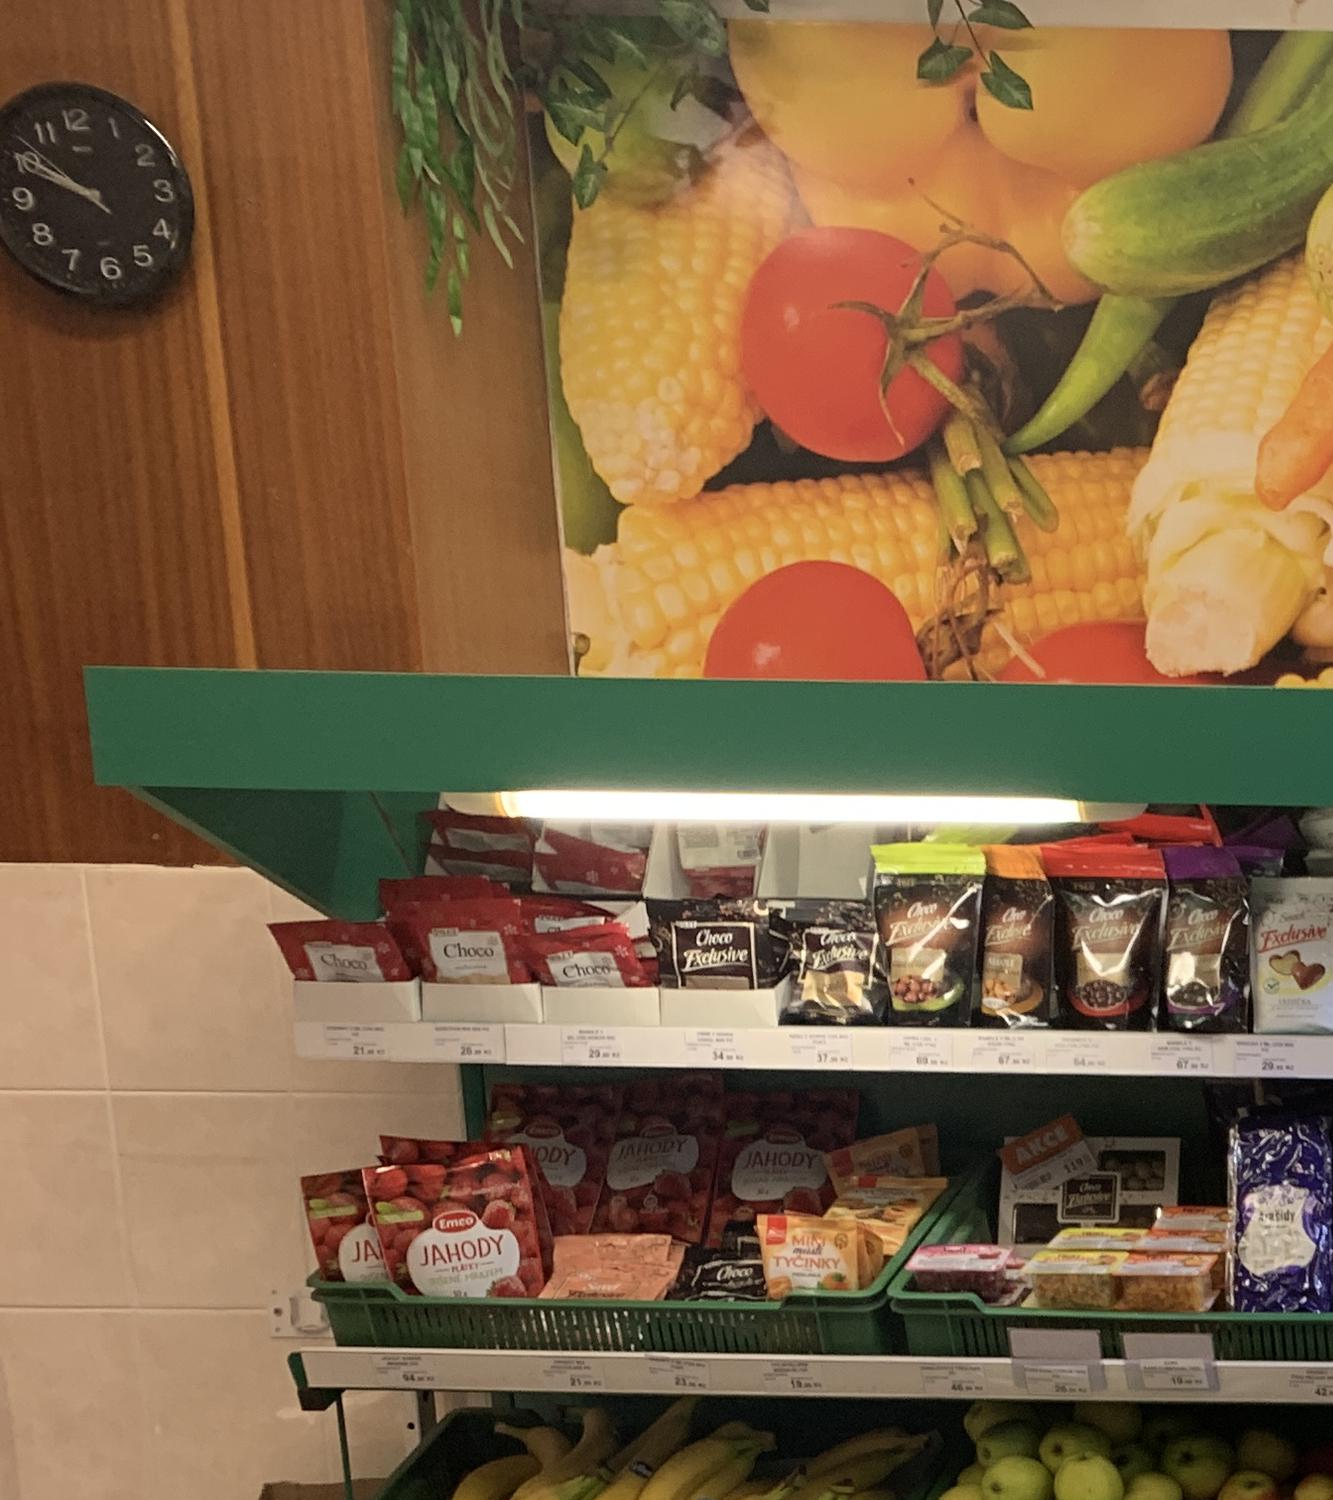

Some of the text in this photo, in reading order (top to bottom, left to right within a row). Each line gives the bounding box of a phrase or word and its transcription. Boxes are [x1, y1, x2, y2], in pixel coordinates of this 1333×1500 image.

[63, 108, 90, 131] 12
[108, 117, 120, 139] 1
[34, 121, 56, 144] 11
[135, 144, 155, 167] 2
[12, 187, 35, 211] 9
[153, 179, 174, 202] 3
[32, 222, 54, 246] 8
[152, 218, 171, 239] 4
[61, 248, 81, 271] 7
[132, 245, 153, 268] 5
[100, 256, 122, 280] 6
[696, 929, 734, 946] Choco
[1257, 925, 1328, 952] Exclusive
[443, 942, 494, 959] Choco
[683, 947, 749, 969] Exclusive
[320, 953, 368, 971] Choco
[562, 962, 610, 979] Choco
[618, 1140, 685, 1159] JAHODY
[1016, 1126, 1067, 1163] AKCE
[745, 1151, 819, 1169] JAHODY
[438, 1215, 474, 1230] Emco
[419, 1233, 504, 1267] JAHODY
[773, 1250, 841, 1269] TYČINKY
[716, 1265, 754, 1282] Choco
